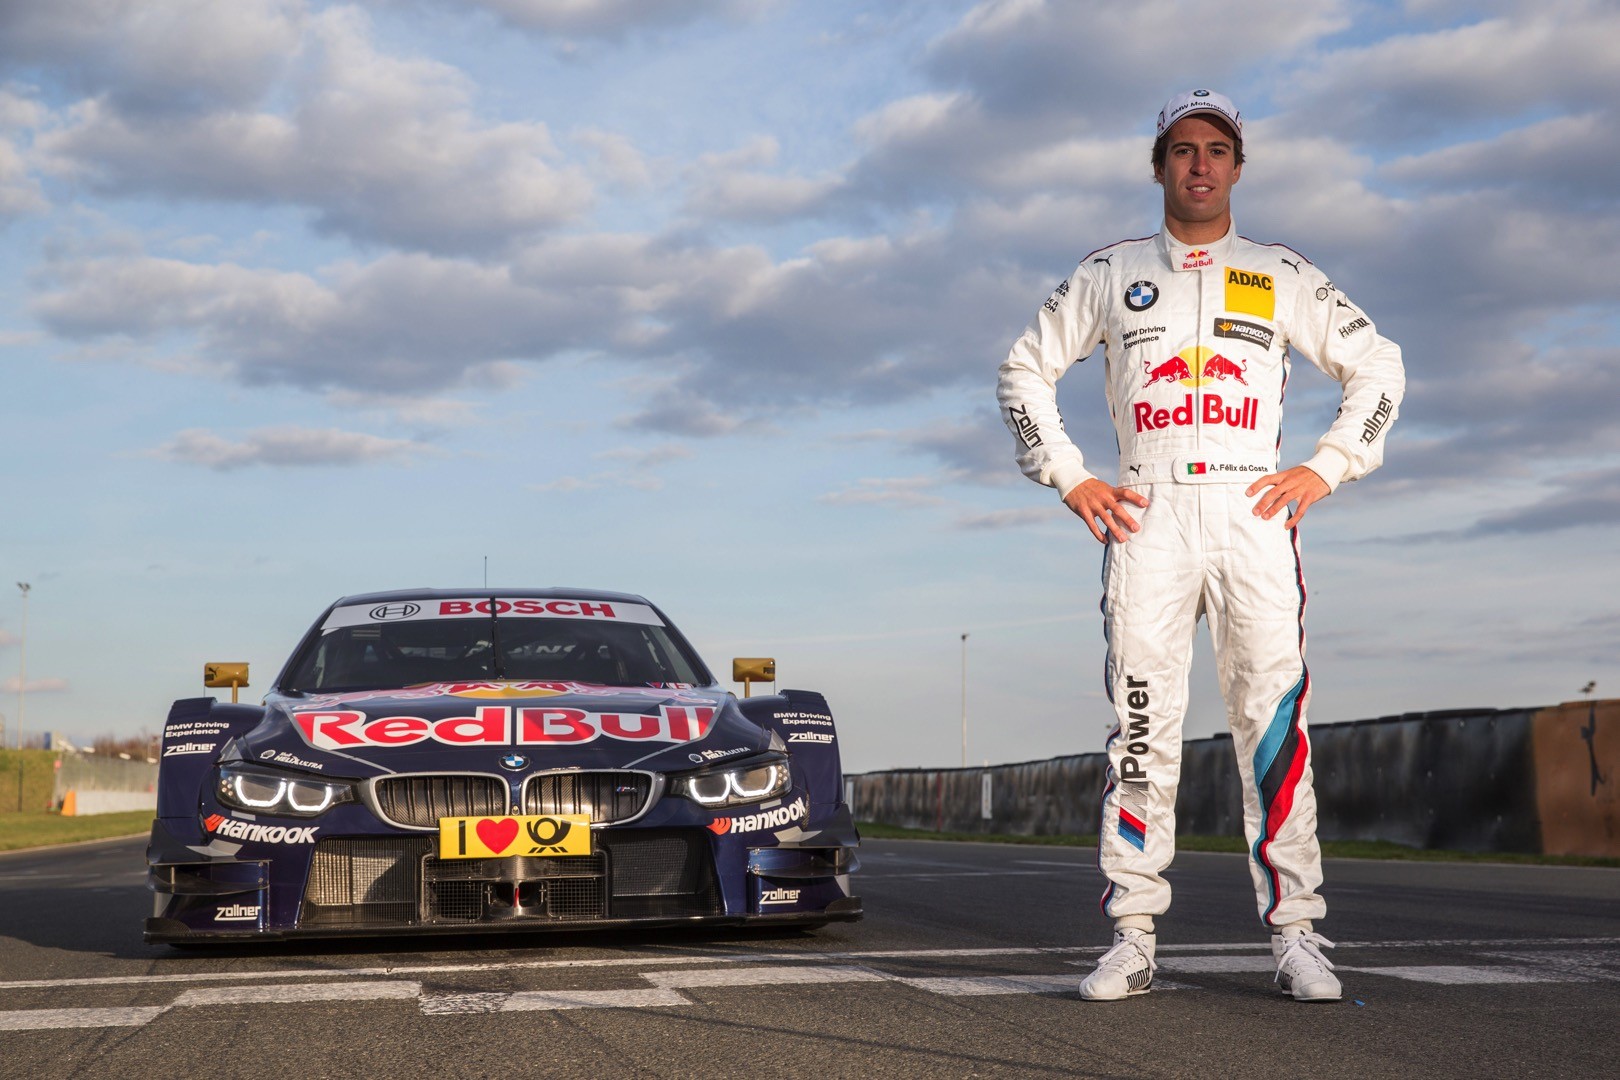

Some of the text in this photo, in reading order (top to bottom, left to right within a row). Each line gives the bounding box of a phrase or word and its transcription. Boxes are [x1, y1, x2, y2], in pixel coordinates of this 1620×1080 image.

[1170, 103, 1189, 117] BMW
[1183, 258, 1213, 269] Red Bull
[1128, 281, 1157, 293] BMW
[1228, 270, 1272, 290] ADAC
[1122, 326, 1166, 341] BMW Driving
[1231, 324, 1272, 342] Hankook
[1124, 335, 1160, 350] Experience
[1134, 394, 1258, 433] Red Bull
[1360, 392, 1393, 447] ollner
[1209, 463, 1218, 472] A.
[1219, 464, 1237, 472] Félix
[1248, 465, 1269, 473] Costa
[439, 600, 616, 618] BOSCH
[782, 718, 832, 726] Experience
[799, 712, 831, 721] Driving
[165, 728, 220, 738] Experience
[166, 722, 193, 731] BMW
[295, 705, 716, 747] Red Bull
[787, 731, 834, 744] zollner
[163, 742, 217, 757] zollner
[728, 746, 751, 755] ULTRA
[299, 760, 324, 770] ULTRA
[730, 796, 806, 834] Hankook
[216, 818, 320, 844] Hankook
[458, 820, 467, 855] I
[759, 887, 801, 905] zollner
[214, 904, 262, 921] zollner
